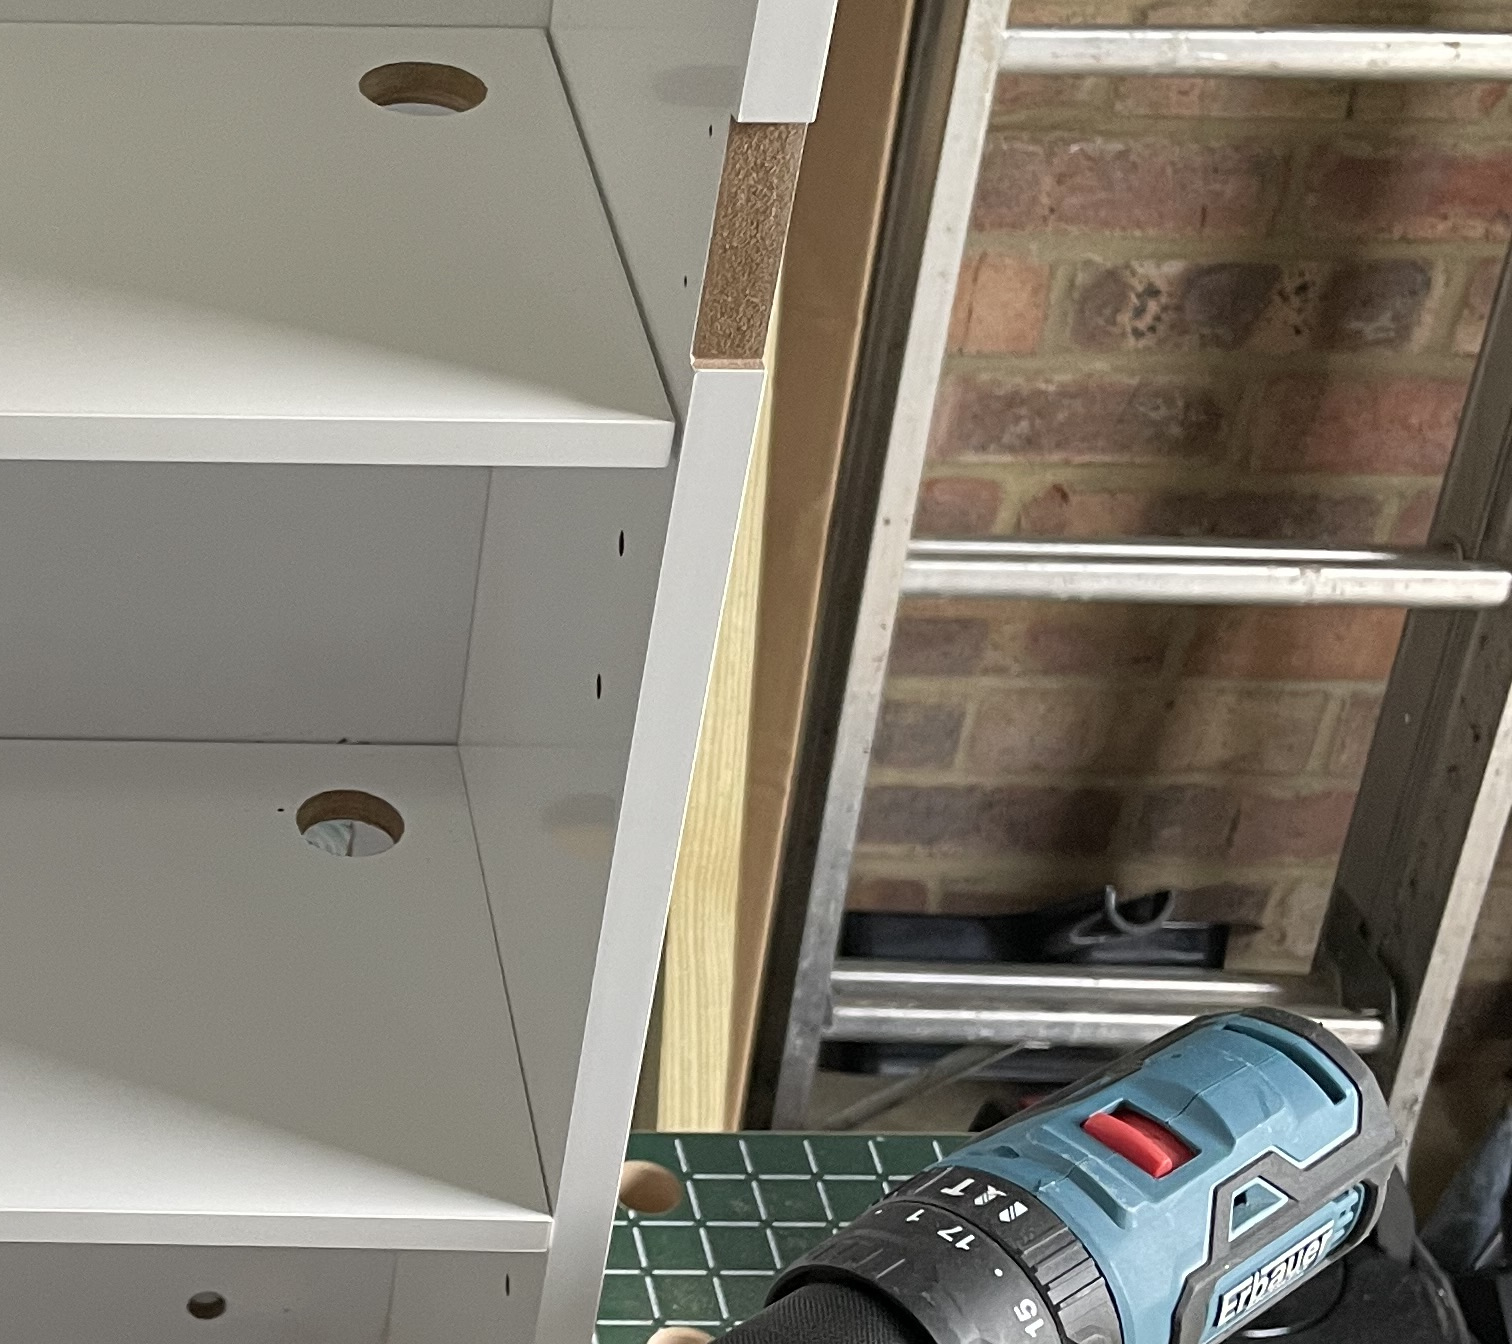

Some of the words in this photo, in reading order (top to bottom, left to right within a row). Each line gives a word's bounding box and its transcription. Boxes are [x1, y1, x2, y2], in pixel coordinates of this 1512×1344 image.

[936, 1225, 976, 1251] 17
[1214, 1219, 1335, 1328] Erbauer
[1013, 1298, 1045, 1338] 15
